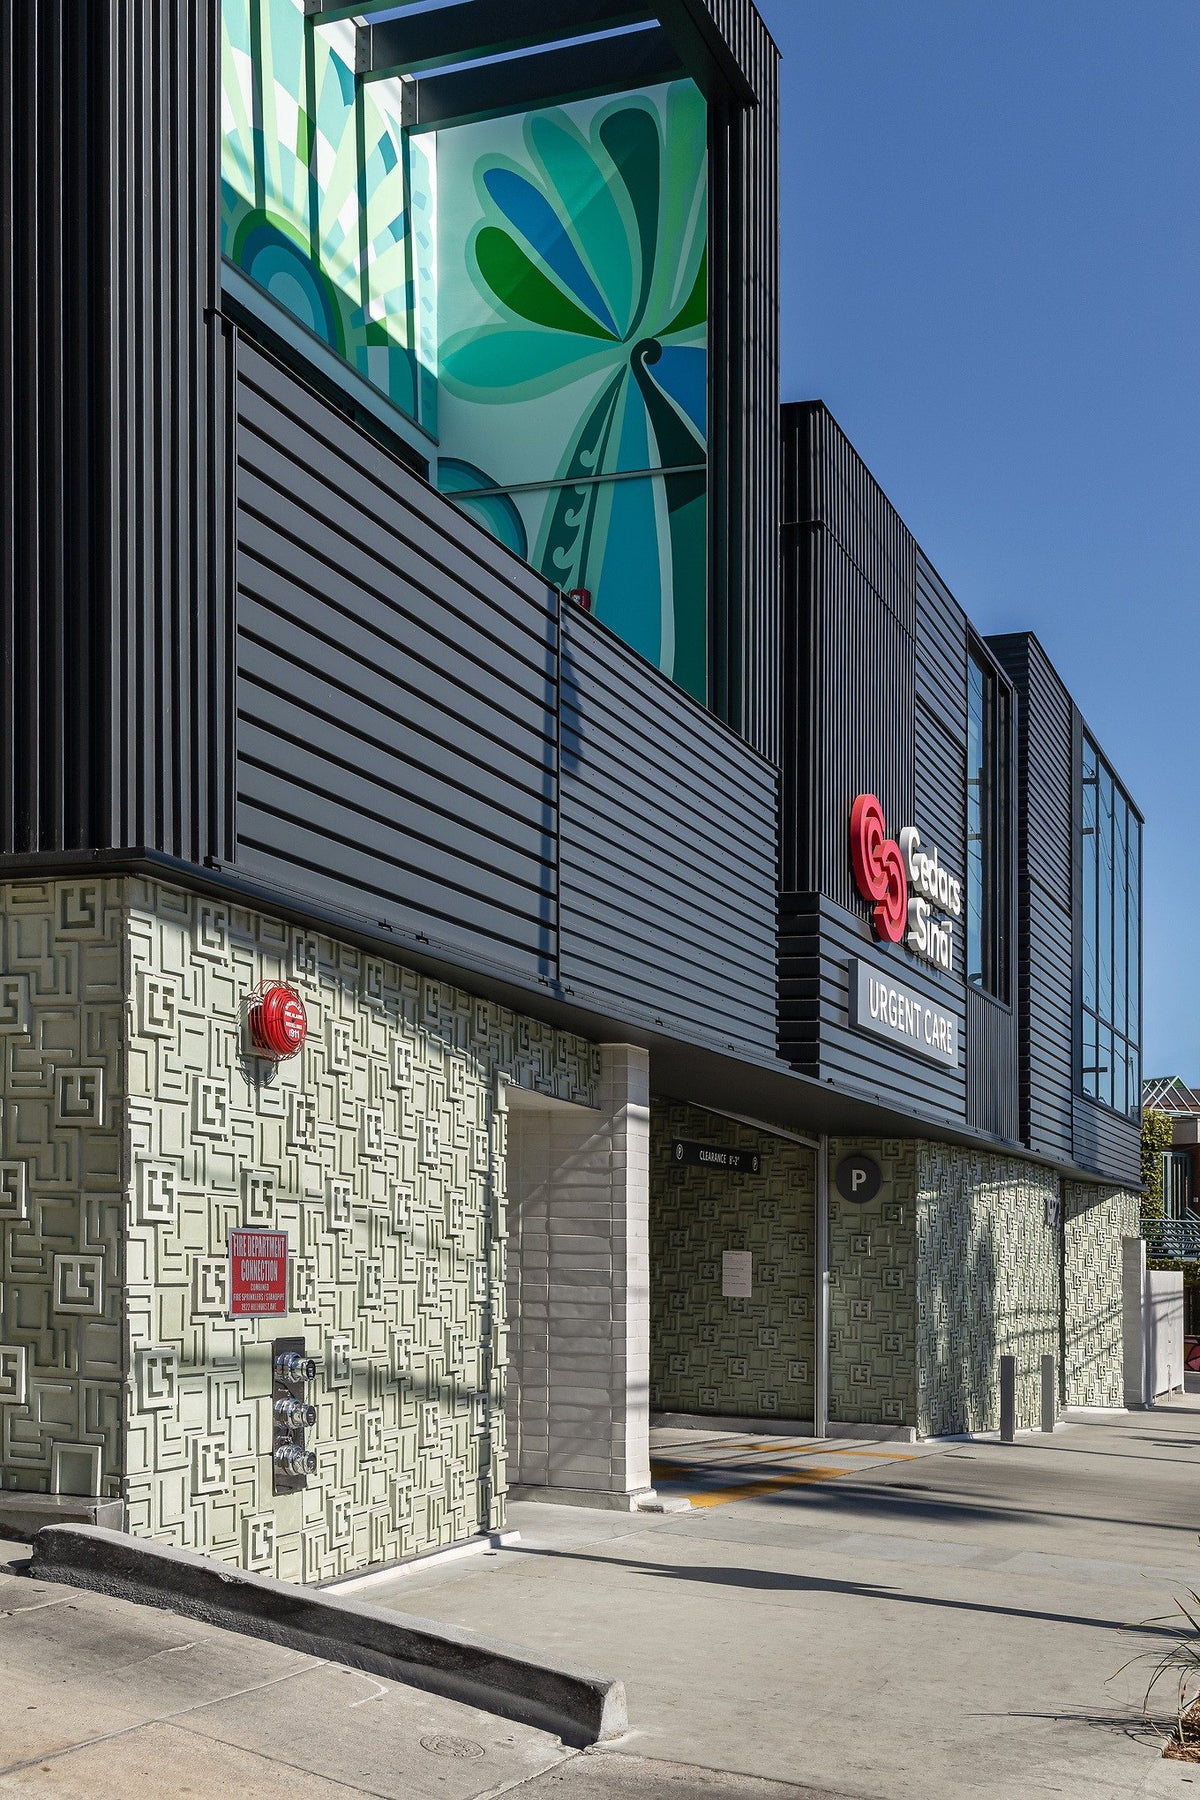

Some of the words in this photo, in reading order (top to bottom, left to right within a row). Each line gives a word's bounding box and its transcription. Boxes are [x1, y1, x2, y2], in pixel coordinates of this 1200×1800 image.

[900, 826, 961, 916] Cedars
[907, 897, 953, 971] Sinai
[869, 977, 922, 1039] URGENT
[924, 1009, 953, 1055] CARE
[699, 1150, 727, 1164] CLEARANCE
[851, 1169, 867, 1192] P
[233, 1235, 247, 1257] FIRE
[247, 1236, 285, 1258] DEPARTMENT
[241, 1259, 278, 1281] CONNECTION
[233, 1293, 241, 1301] FIRE
